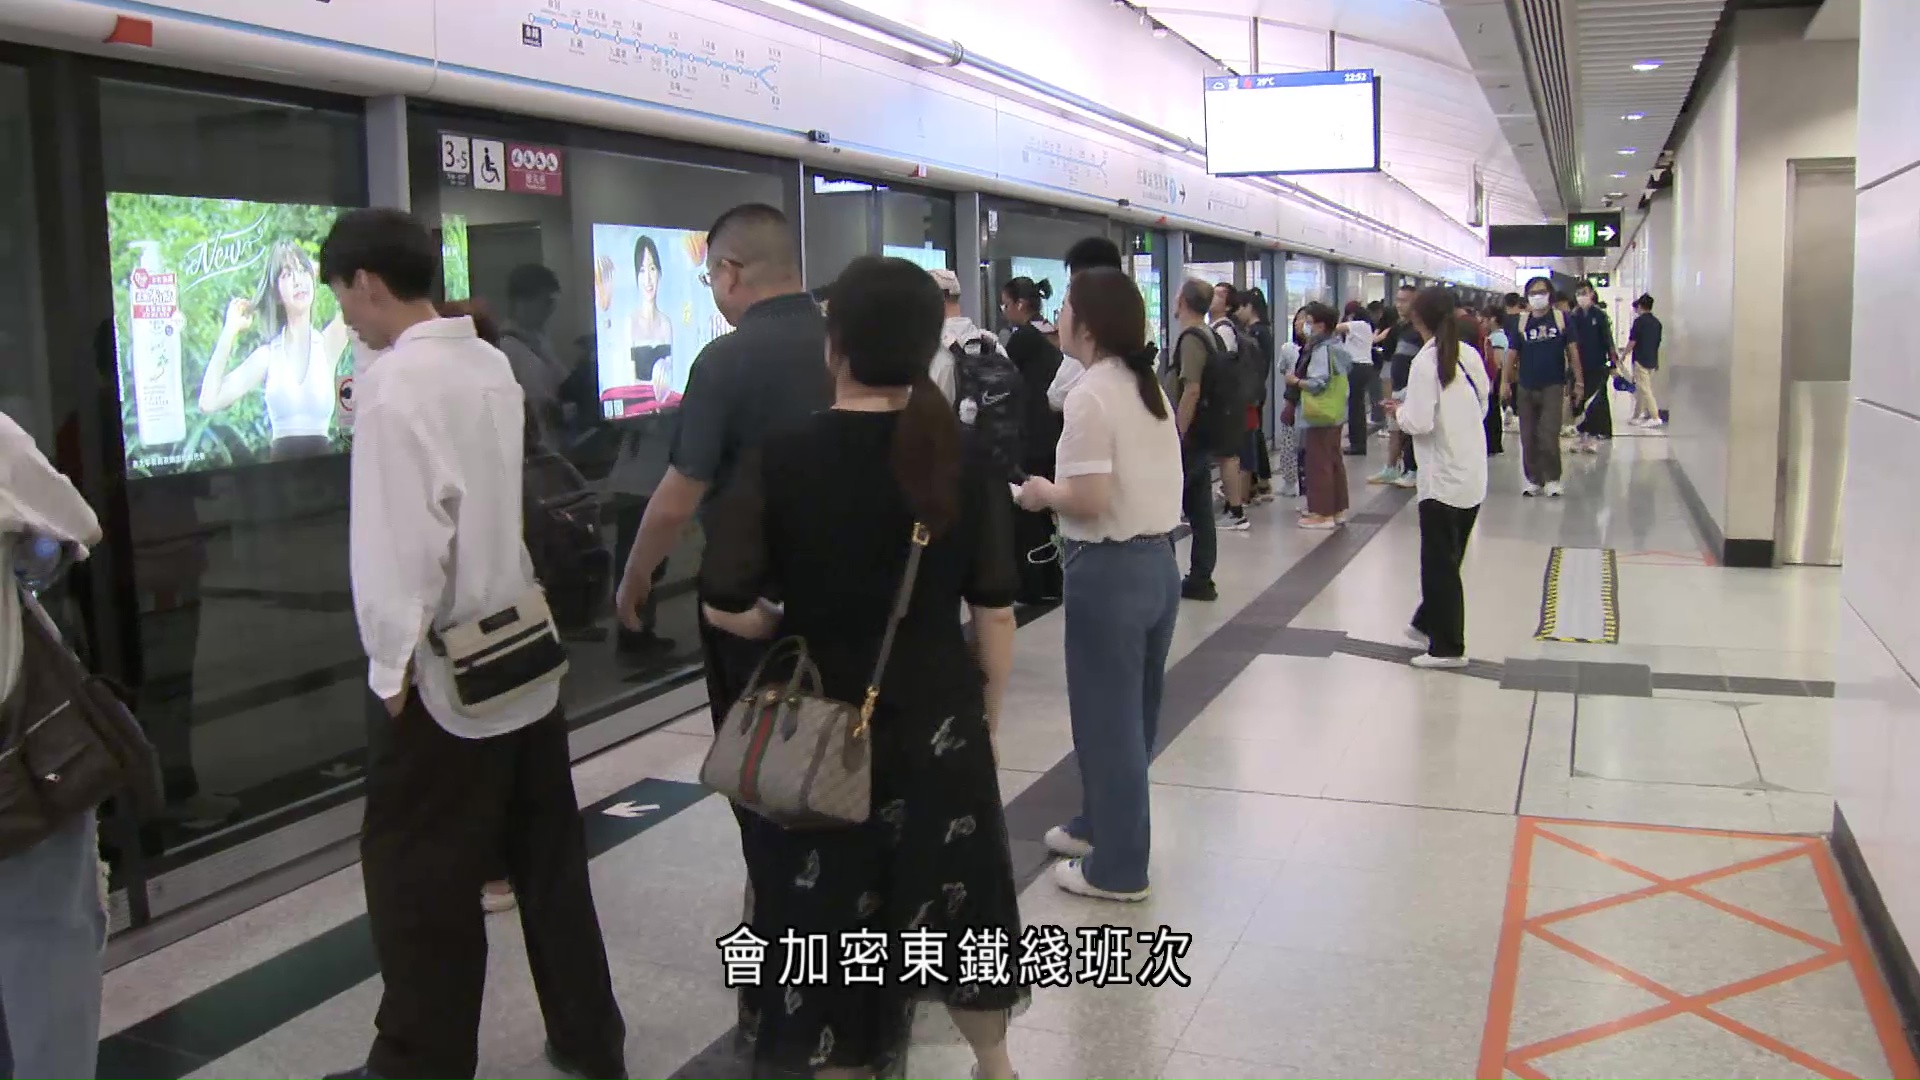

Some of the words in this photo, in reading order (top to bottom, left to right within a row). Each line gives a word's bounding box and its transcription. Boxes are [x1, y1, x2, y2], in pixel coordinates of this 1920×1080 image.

[1343, 72, 1367, 82] 22:52
[445, 140, 468, 169] 3-5
[186, 229, 255, 275] New
